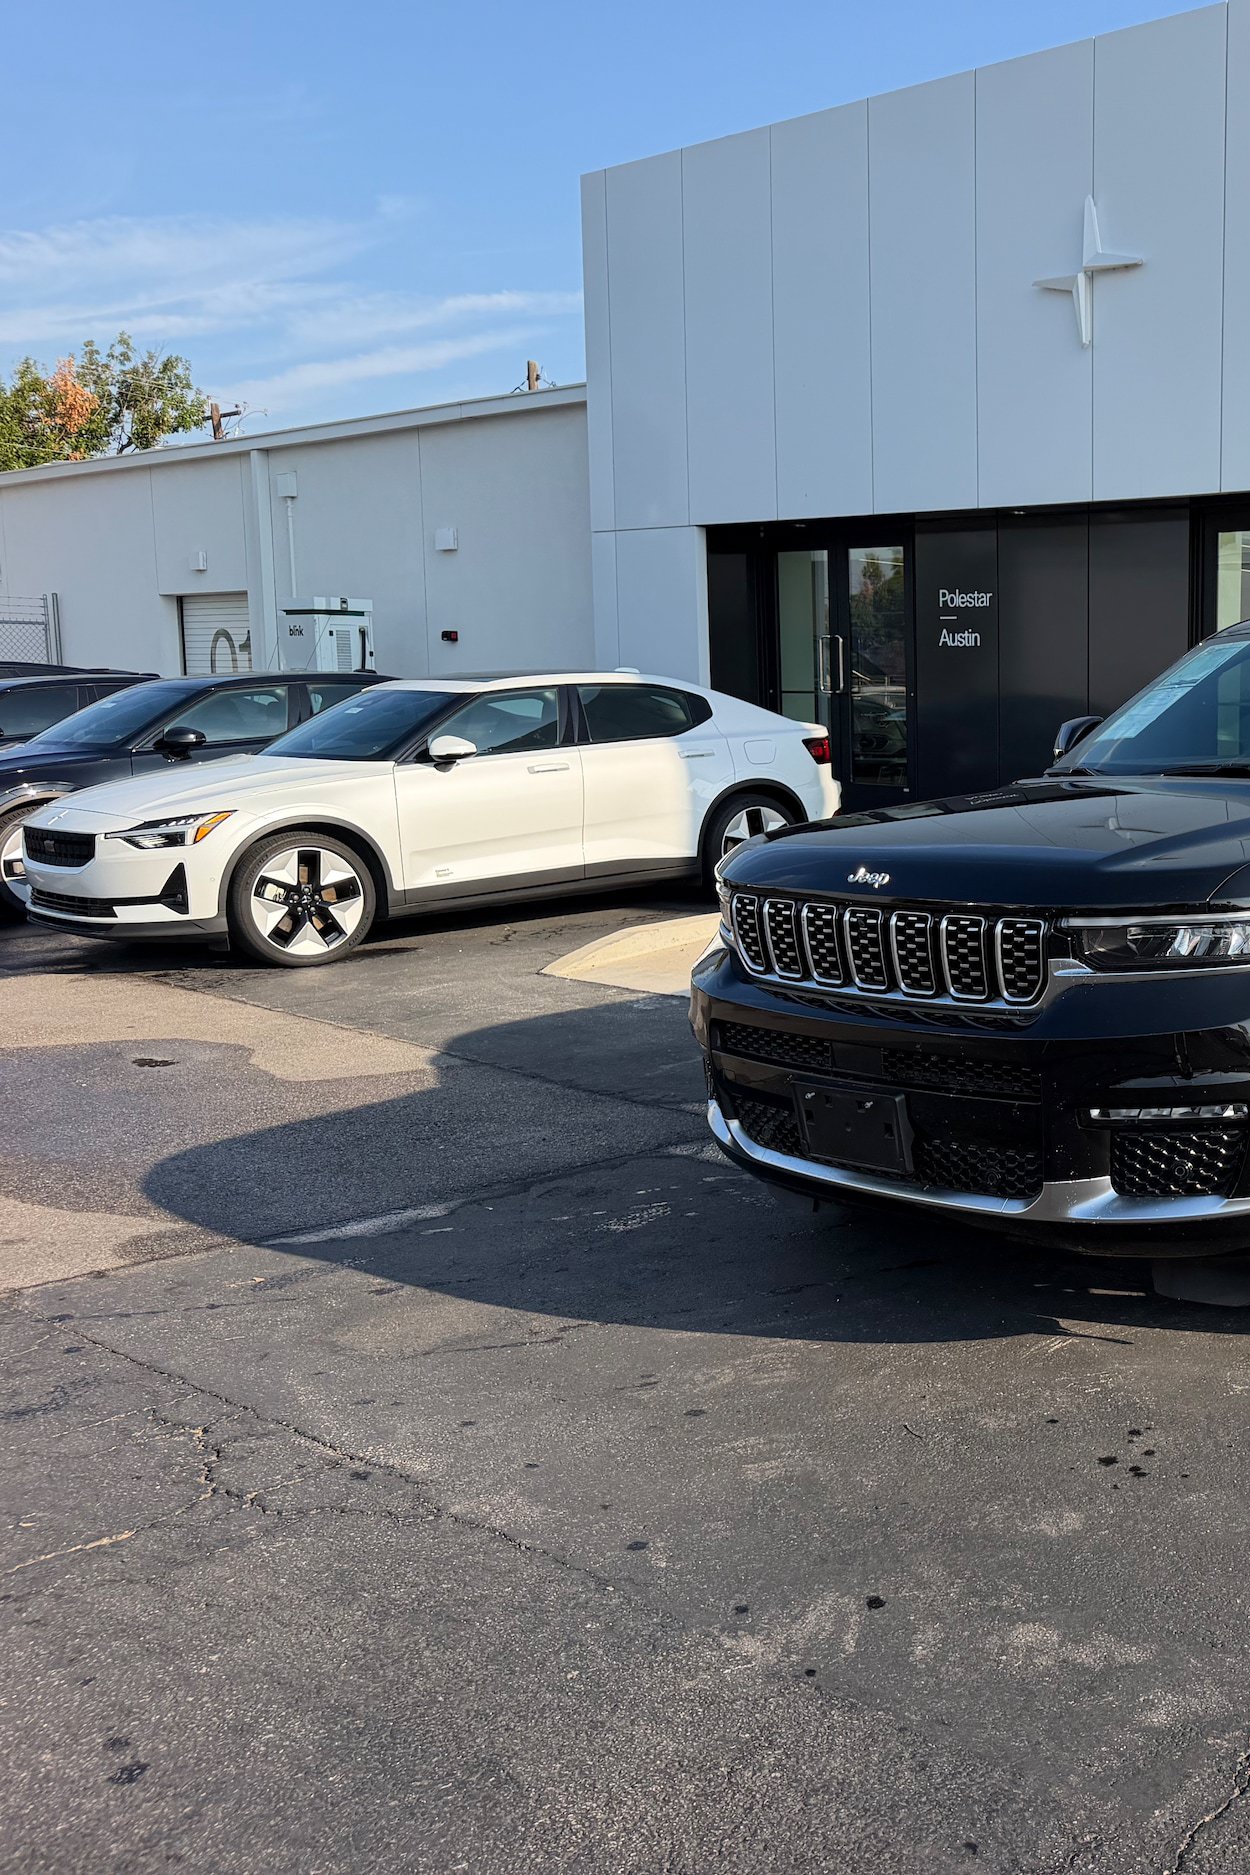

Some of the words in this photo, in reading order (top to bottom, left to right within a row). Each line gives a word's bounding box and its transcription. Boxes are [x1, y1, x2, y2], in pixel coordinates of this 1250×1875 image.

[939, 588, 993, 608] Polestar
[288, 625, 304, 637] blink
[938, 628, 981, 647] Austin
[847, 866, 890, 889] Jeep
